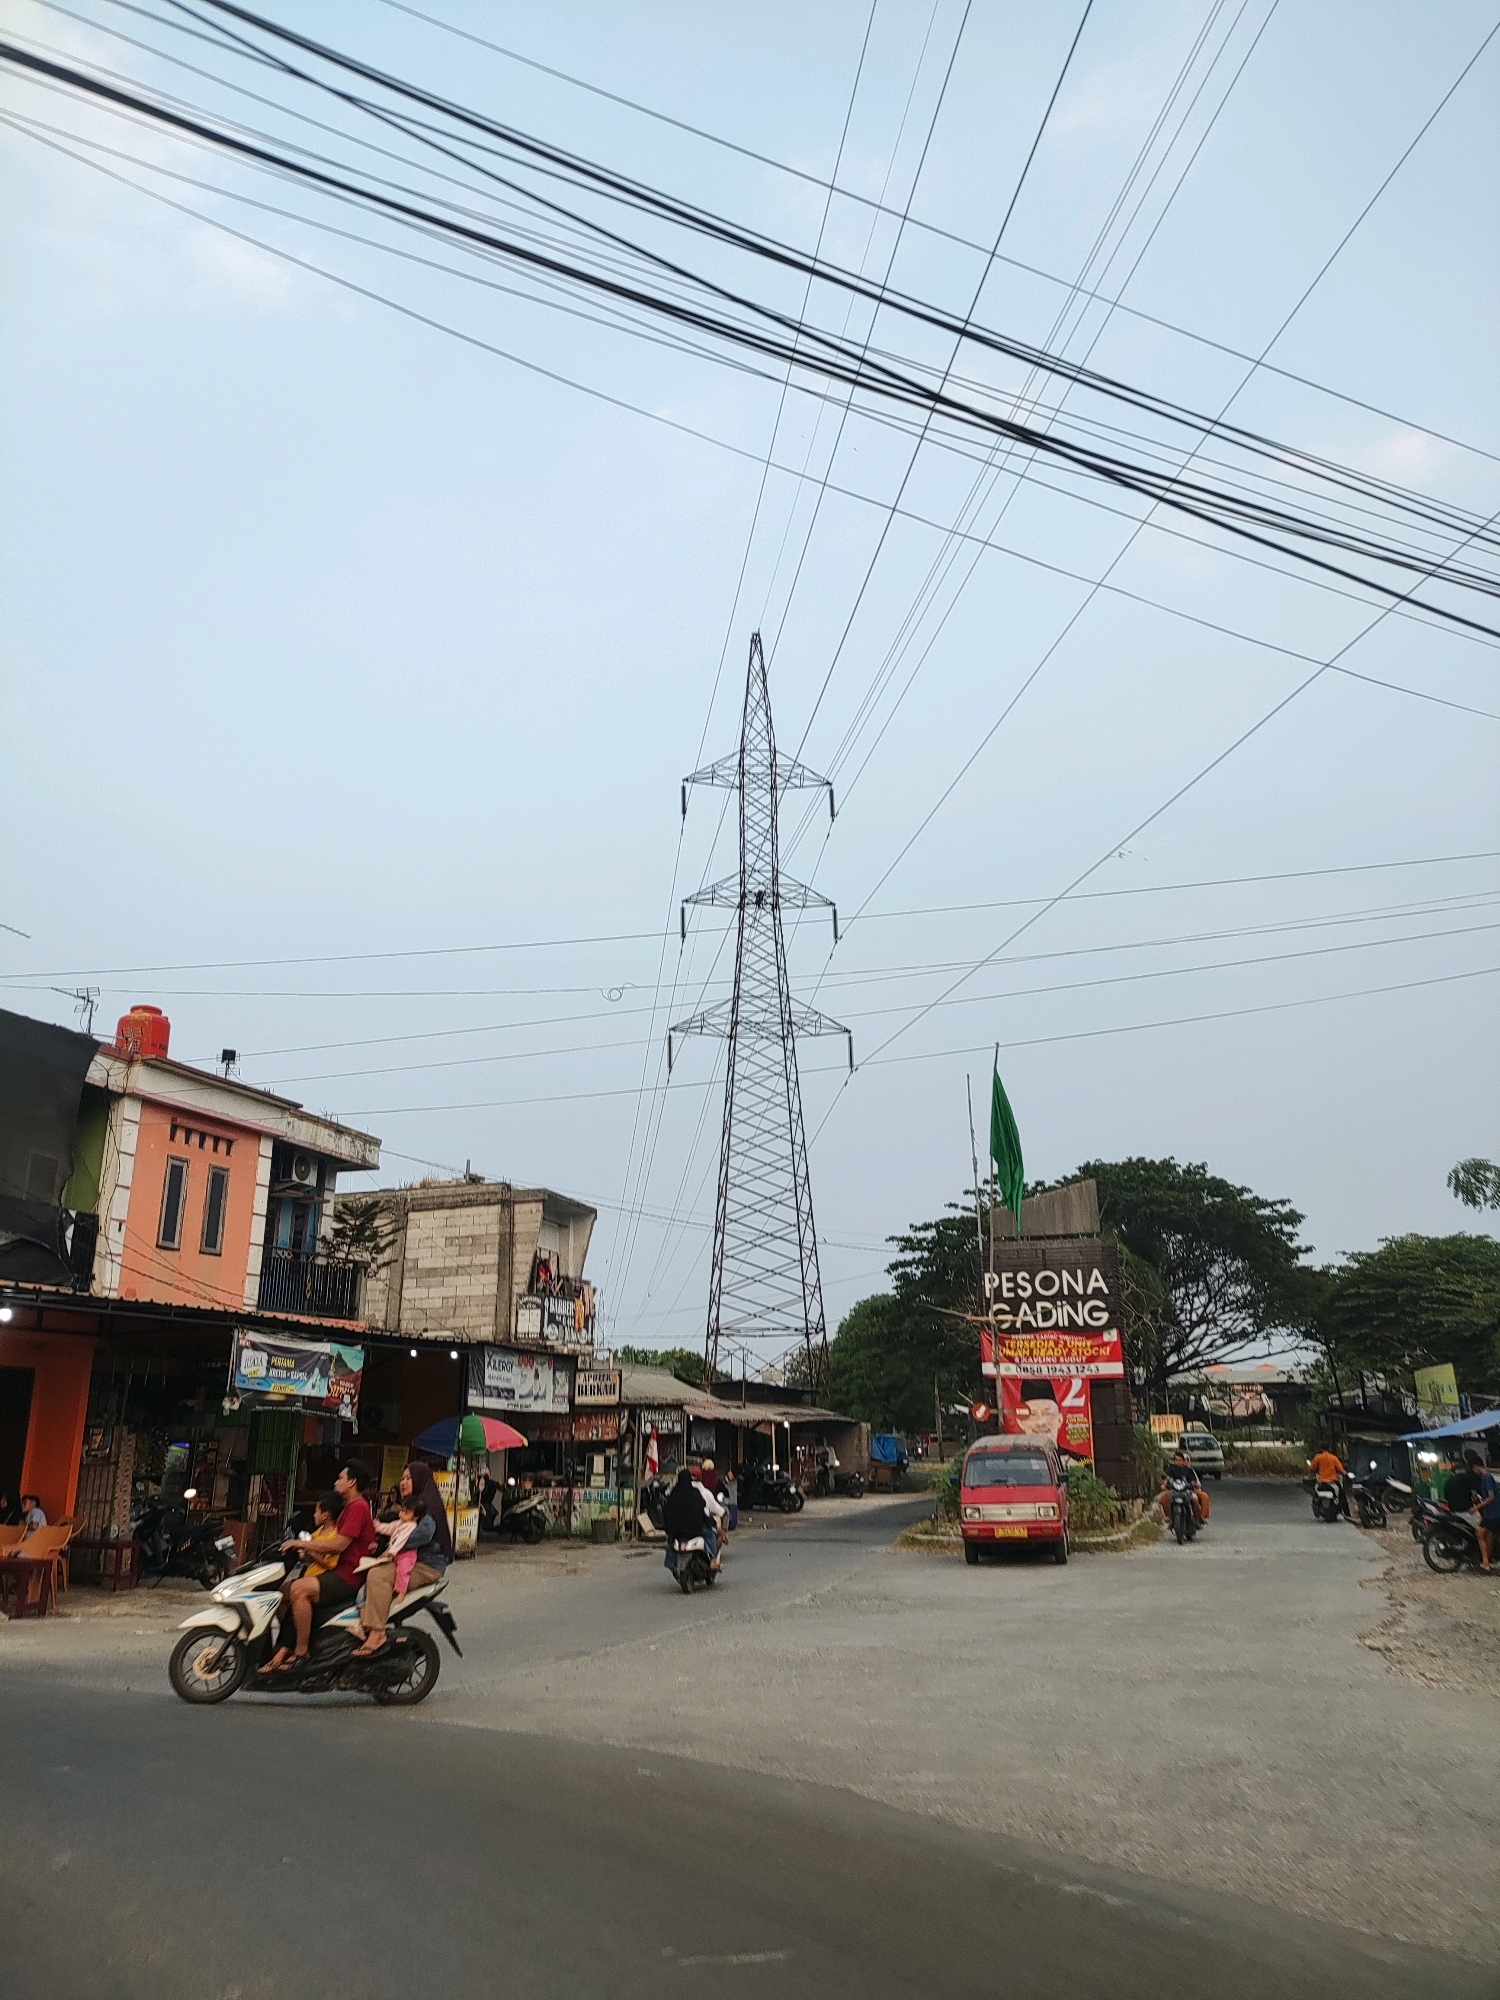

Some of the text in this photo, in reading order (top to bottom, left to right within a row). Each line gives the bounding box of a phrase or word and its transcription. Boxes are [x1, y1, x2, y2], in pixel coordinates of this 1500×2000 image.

[984, 1268, 1109, 1298] PESONA
[989, 1300, 1109, 1329] GADING
[1004, 1340, 1055, 1350] TERSEDIA
[1066, 1339, 1092, 1349] UNIT
[1033, 1346, 1069, 1357] READY
[1062, 1379, 1086, 1407] 2
